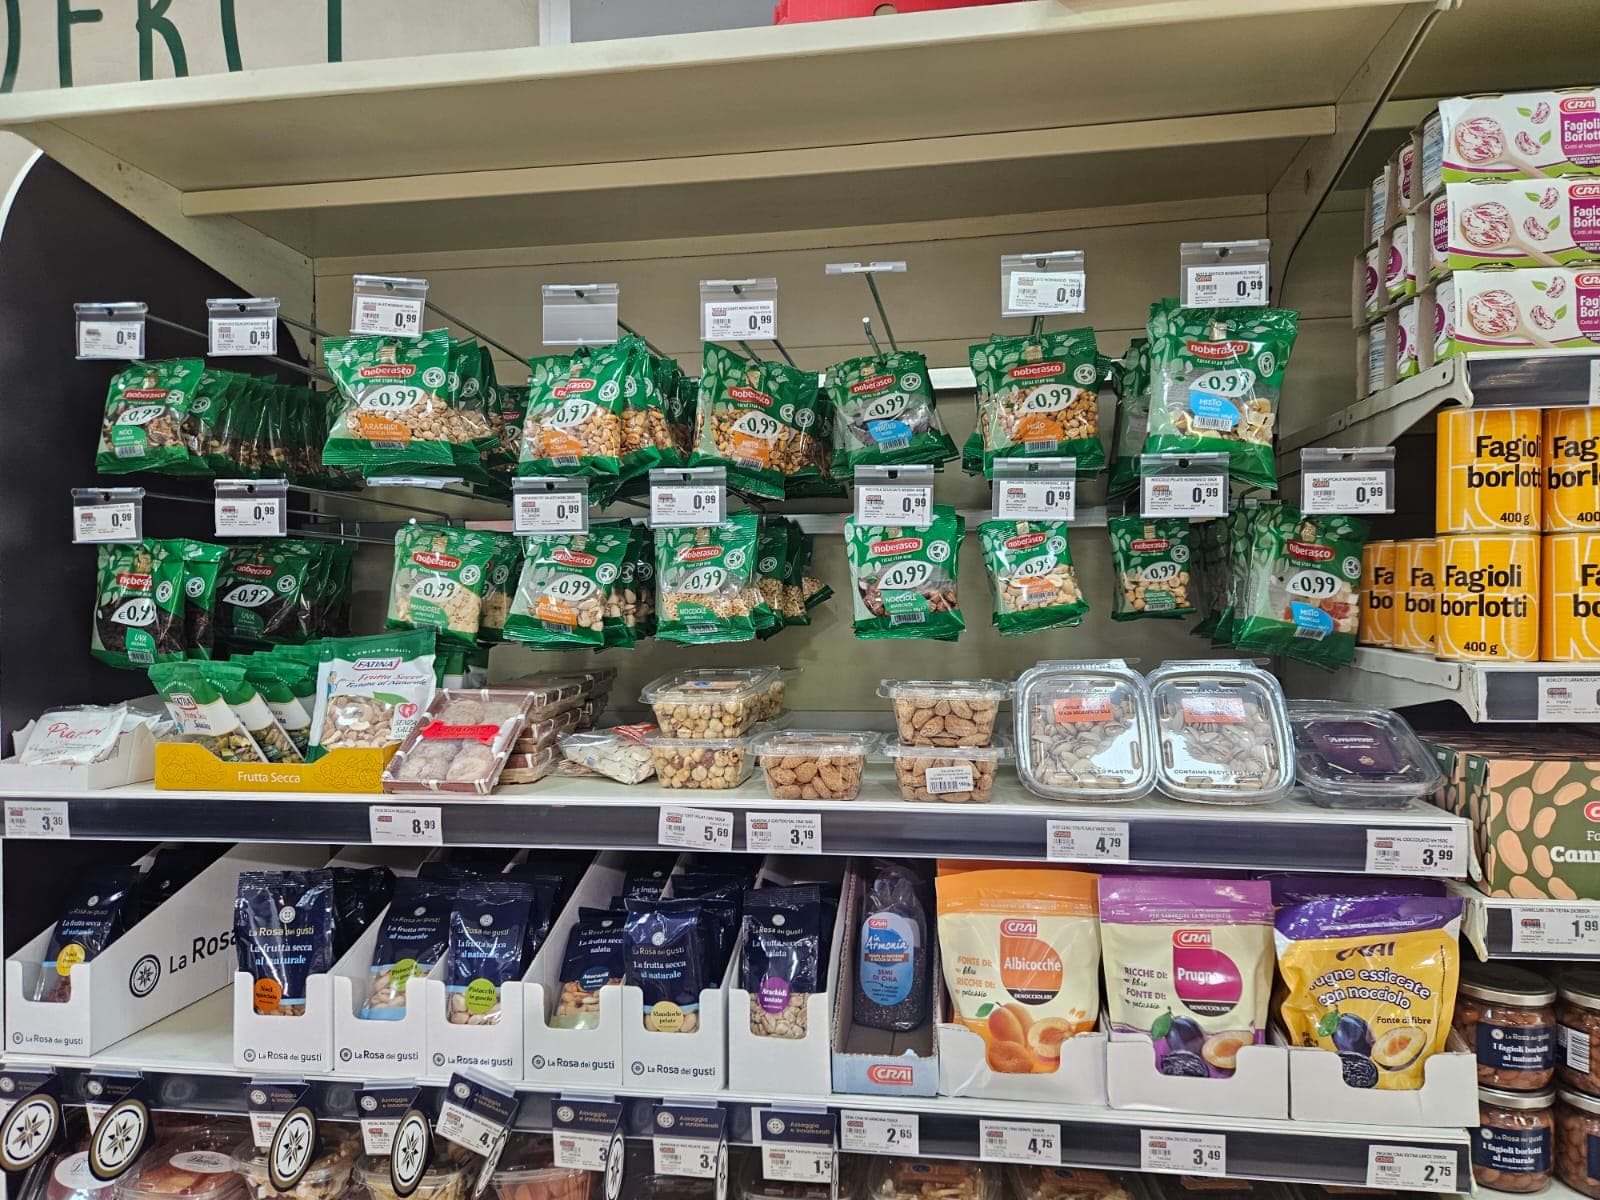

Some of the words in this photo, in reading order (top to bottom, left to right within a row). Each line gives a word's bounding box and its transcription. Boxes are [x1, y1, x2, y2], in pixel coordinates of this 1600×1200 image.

[1566, 100, 1595, 109] CRAI
[1056, 288, 1082, 303] 0,99
[1237, 280, 1263, 297] 0,99
[395, 312, 417, 328] 0,99
[748, 315, 772, 330] 0,99
[117, 330, 137, 345] 0,99
[250, 330, 271, 346] 0,99
[1190, 343, 1244, 357] noberasco
[1013, 365, 1061, 377] noberasco
[853, 376, 893, 394] noberasco
[1547, 462, 1600, 489] borl
[694, 494, 716, 509] 0,99
[1046, 491, 1071, 506] 0,99
[1192, 487, 1219, 504] 0,99
[1356, 487, 1383, 503] 0,99
[903, 497, 926, 513] 0,99
[254, 506, 275, 521] 0,99
[557, 505, 580, 520] 0,99
[1500, 512, 1522, 523] 400
[1523, 514, 1530, 525] g
[112, 513, 132, 528] 0,99
[874, 540, 919, 554] noberasco
[1445, 564, 1522, 593] Fagioli
[1440, 594, 1528, 618] borlotti
[134, 633, 147, 642] UVA
[1463, 641, 1487, 652] 400
[1489, 643, 1498, 655] g
[357, 660, 394, 668] FATINA
[237, 771, 269, 782] Frutta
[271, 771, 301, 783] Secca
[42, 815, 63, 832] 3,39
[412, 819, 435, 835] 8,99
[704, 826, 729, 843] 5,69
[790, 829, 814, 846] 3,19
[1096, 837, 1121, 854] 4,79
[1422, 848, 1453, 867] 3,99
[295, 925, 315, 937] gusti
[1008, 922, 1037, 932] CRAI
[1572, 920, 1599, 938] 1,99
[866, 937, 908, 950] Armonia
[1180, 932, 1212, 944] CRAI
[169, 955, 187, 974] La
[191, 931, 236, 963] Rosa
[291, 943, 313, 952] secca
[1335, 941, 1397, 962] CRAI
[640, 961, 663, 969] frutta
[665, 960, 687, 969] secca
[957, 955, 980, 967] FONTE
[981, 958, 992, 968] DI:
[1004, 955, 1062, 972] Albicocche
[648, 970, 682, 979] naturale
[1124, 967, 1155, 978] RICCHE
[1156, 970, 1168, 980] DI:
[956, 976, 983, 988] RICCHE
[984, 980, 996, 988] DI:
[1358, 967, 1432, 1000] essiccate
[1126, 988, 1153, 999] FONTE
[1154, 991, 1166, 1000] DI:
[1317, 989, 1347, 1007] con
[1347, 986, 1412, 1010] nocciolo
[1376, 1015, 1401, 1024] Fonte
[1410, 1015, 1432, 1025] fibre
[33, 1033, 53, 1044] Rosa
[63, 1037, 84, 1046] gusti
[1512, 1032, 1530, 1041] Rosa
[1498, 1042, 1524, 1054] fagioli
[267, 1051, 288, 1060] Rosa
[300, 1052, 322, 1062] gusti
[363, 1050, 384, 1060] Rosa
[396, 1051, 419, 1061] gusti
[456, 1056, 478, 1065] Rosa
[491, 1057, 513, 1067] gusti
[1512, 1054, 1542, 1063] naturale
[556, 1058, 579, 1067] Rosa
[591, 1060, 615, 1070] gusti
[656, 1064, 679, 1074] Rosa
[692, 1066, 716, 1077] gusti
[877, 1066, 912, 1080] CRAI
[887, 1127, 912, 1144] 2,65
[1501, 1133, 1520, 1143] Rosa
[1028, 1138, 1053, 1154] 4,75
[1488, 1142, 1514, 1155] fagioli
[1515, 1145, 1542, 1155] borlotti
[1192, 1149, 1221, 1166] 3,49
[1503, 1155, 1535, 1165] naturale
[1423, 1165, 1452, 1183] 2,75
